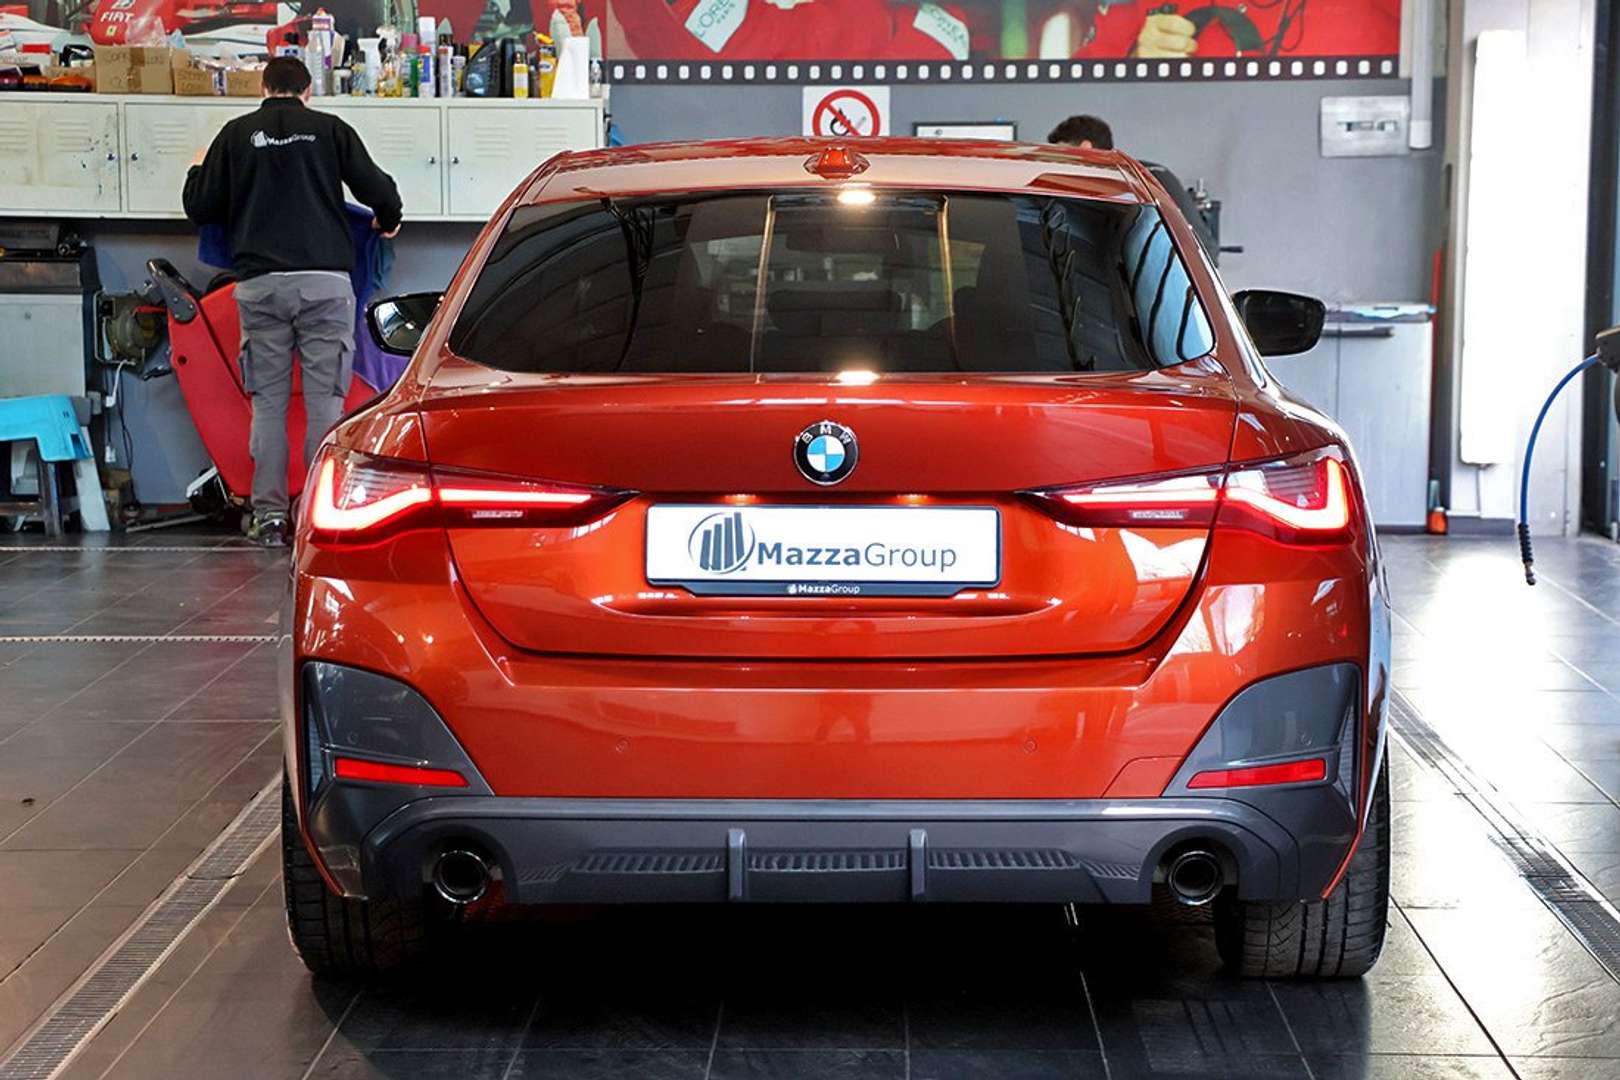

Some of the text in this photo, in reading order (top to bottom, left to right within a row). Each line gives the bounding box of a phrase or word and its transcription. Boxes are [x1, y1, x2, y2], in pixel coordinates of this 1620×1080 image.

[100, 12, 135, 22] FIAT
[801, 424, 853, 444] BMW
[757, 542, 957, 572] MazzaGroup
[798, 584, 860, 595] MazzaGroup
